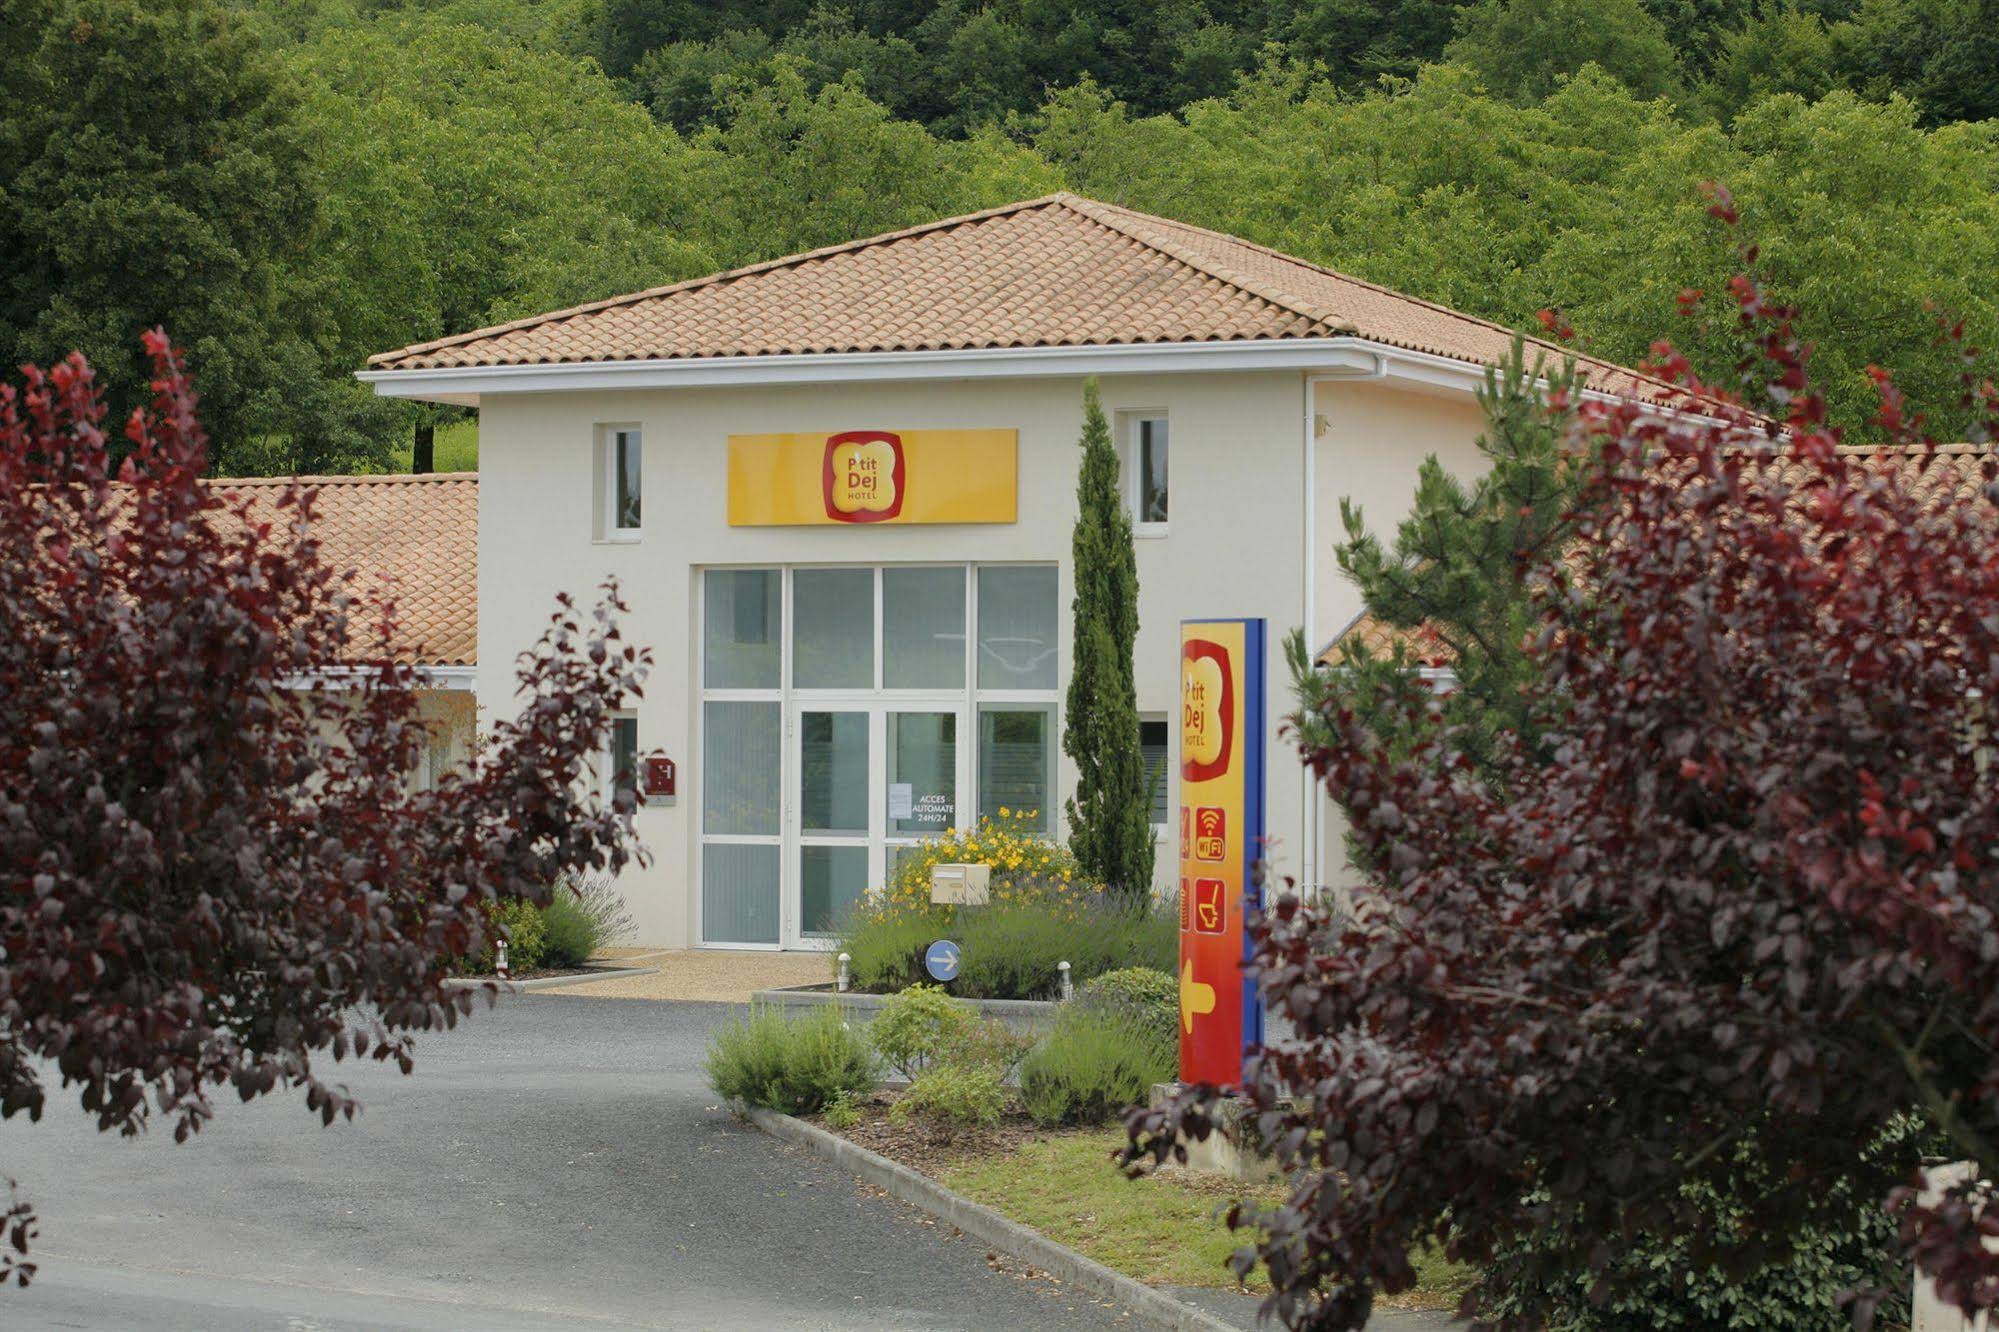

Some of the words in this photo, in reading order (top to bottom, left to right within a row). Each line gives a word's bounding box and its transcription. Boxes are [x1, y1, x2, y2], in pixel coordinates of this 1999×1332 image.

[848, 471, 877, 491] Dej
[848, 492, 878, 500] HOTEL
[1185, 702, 1204, 734] Dej
[1185, 735, 1205, 746] HOTEL
[920, 795, 946, 804] ACCES
[912, 805, 954, 813] AUTOMATE
[918, 814, 946, 822] 24H/24
